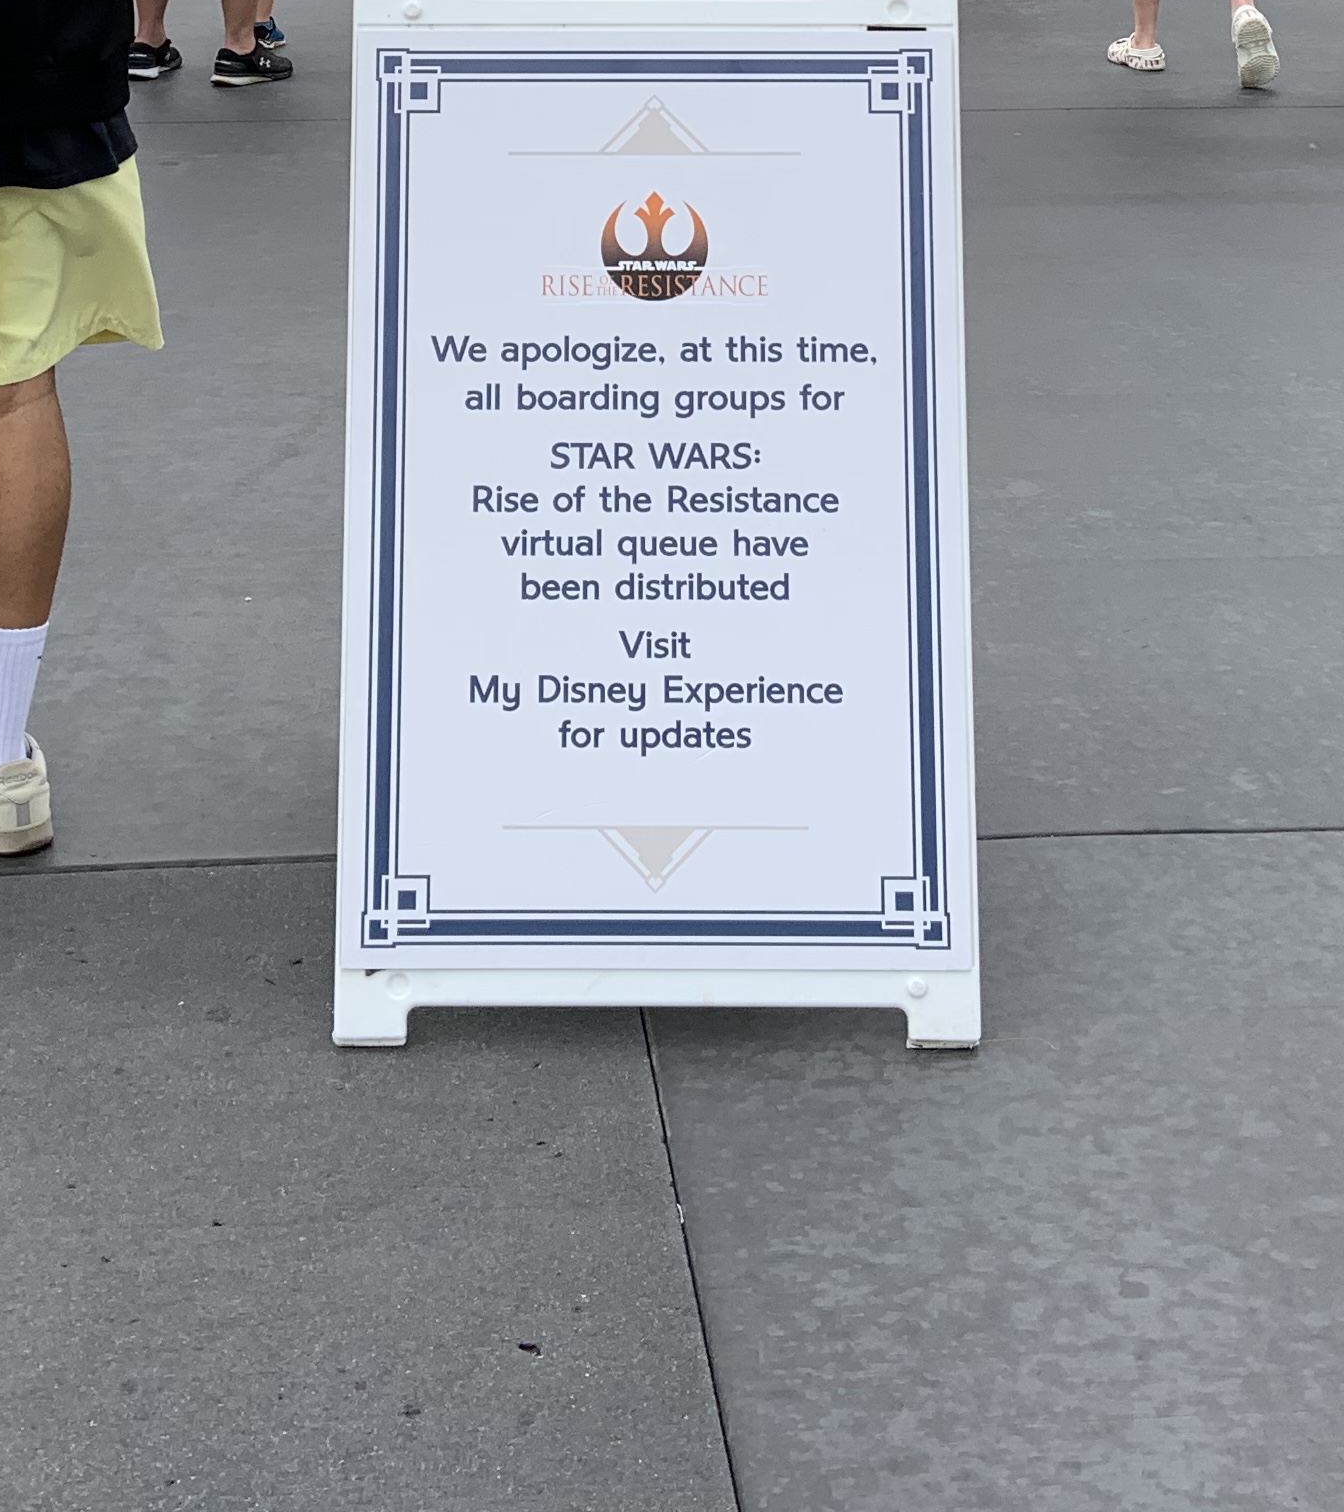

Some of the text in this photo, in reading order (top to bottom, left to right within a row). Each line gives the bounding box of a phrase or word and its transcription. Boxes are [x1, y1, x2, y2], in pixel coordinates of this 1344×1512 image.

[617, 260, 698, 272] STAR WARS
[541, 274, 593, 297] RISE
[597, 286, 619, 297] THE
[620, 274, 769, 297] RESISTANCE
[430, 335, 877, 371] We apologize, at this time,
[464, 383, 845, 419] all boarding groups for
[550, 441, 761, 470] STAR WARS:
[472, 485, 840, 514] Rise of the Resistance
[500, 528, 809, 565] virtual queue have
[521, 572, 790, 601] been distributed
[618, 630, 692, 659] Visit
[469, 674, 844, 713] My Disney Experience
[558, 719, 752, 757] for updates
